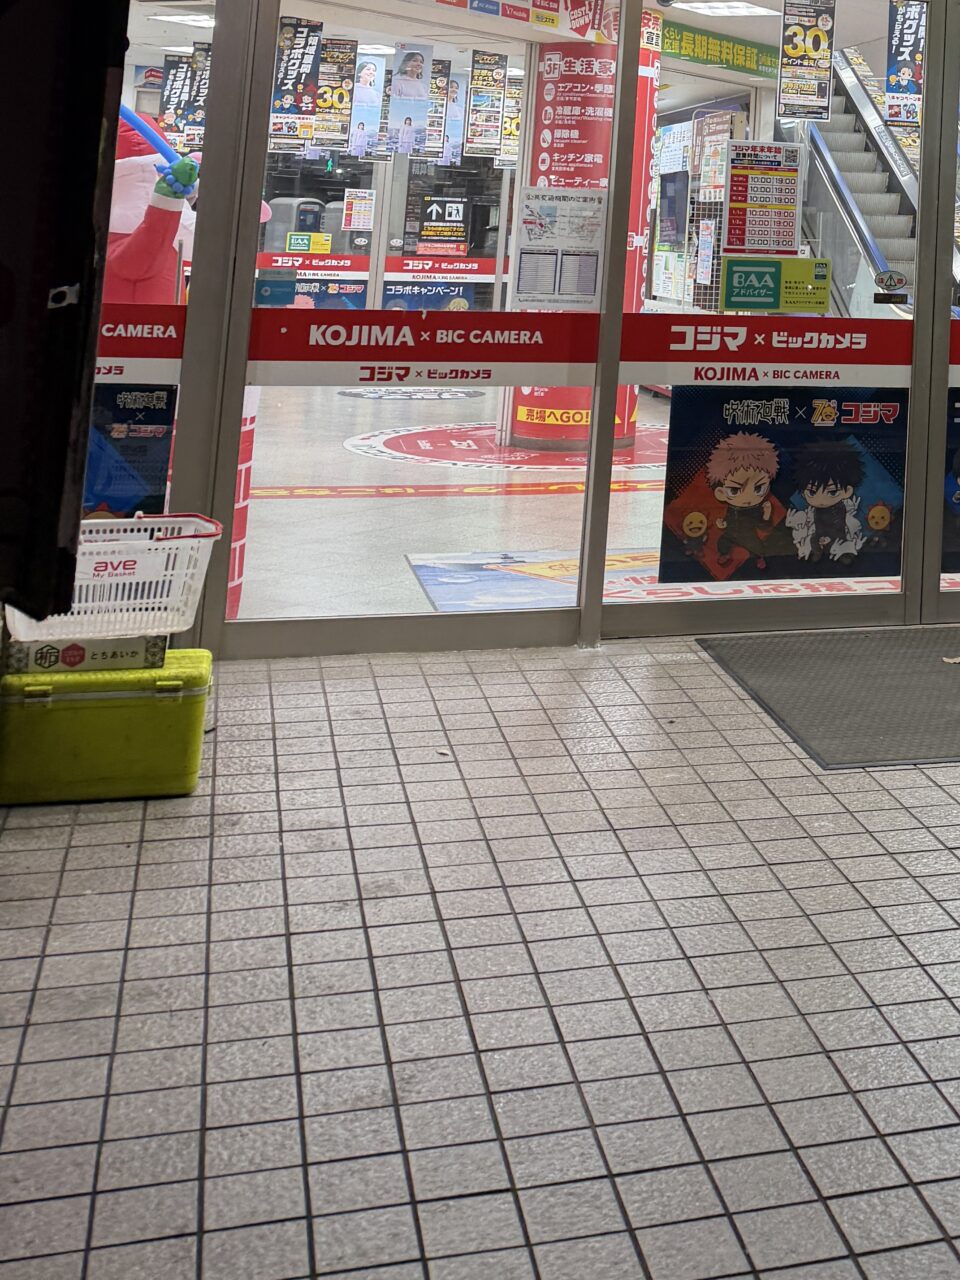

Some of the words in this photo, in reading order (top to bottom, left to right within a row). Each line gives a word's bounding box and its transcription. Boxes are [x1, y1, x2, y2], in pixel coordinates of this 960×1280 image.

[897, 1, 920, 61] ボグッズ
[783, 25, 829, 59] 30
[681, 31, 758, 71] 長期無料保証
[751, 176, 772, 184] 10:00
[774, 196, 796, 204] 19:00
[774, 210, 795, 218] 19:00
[773, 220, 794, 228] 19:00
[772, 230, 794, 238] 19:00
[272, 256, 303, 267] コジマ
[403, 260, 433, 270] コジマ
[733, 272, 774, 288] BAA
[386, 285, 463, 296] コラボキャンペーン!
[732, 288, 774, 296] アドバイザー
[101, 324, 177, 339] CAMERA
[309, 324, 415, 347] KOJIMA
[436, 329, 466, 344] BIC
[469, 329, 543, 345] CAMERA
[669, 325, 748, 352] コジマ
[771, 331, 867, 350] ビックカメラ
[358, 366, 411, 382] コジマ
[427, 368, 492, 380] ビックカメラ
[693, 366, 759, 382] KOJIMA
[772, 369, 791, 380] BIC
[793, 369, 840, 380] CAMERA
[525, 407, 591, 424] 売場へGO!
[723, 397, 790, 426] 呪術廻戦
[841, 402, 900, 425] コジマ
[93, 559, 138, 572] ave
[90, 650, 140, 663] とちあいか
